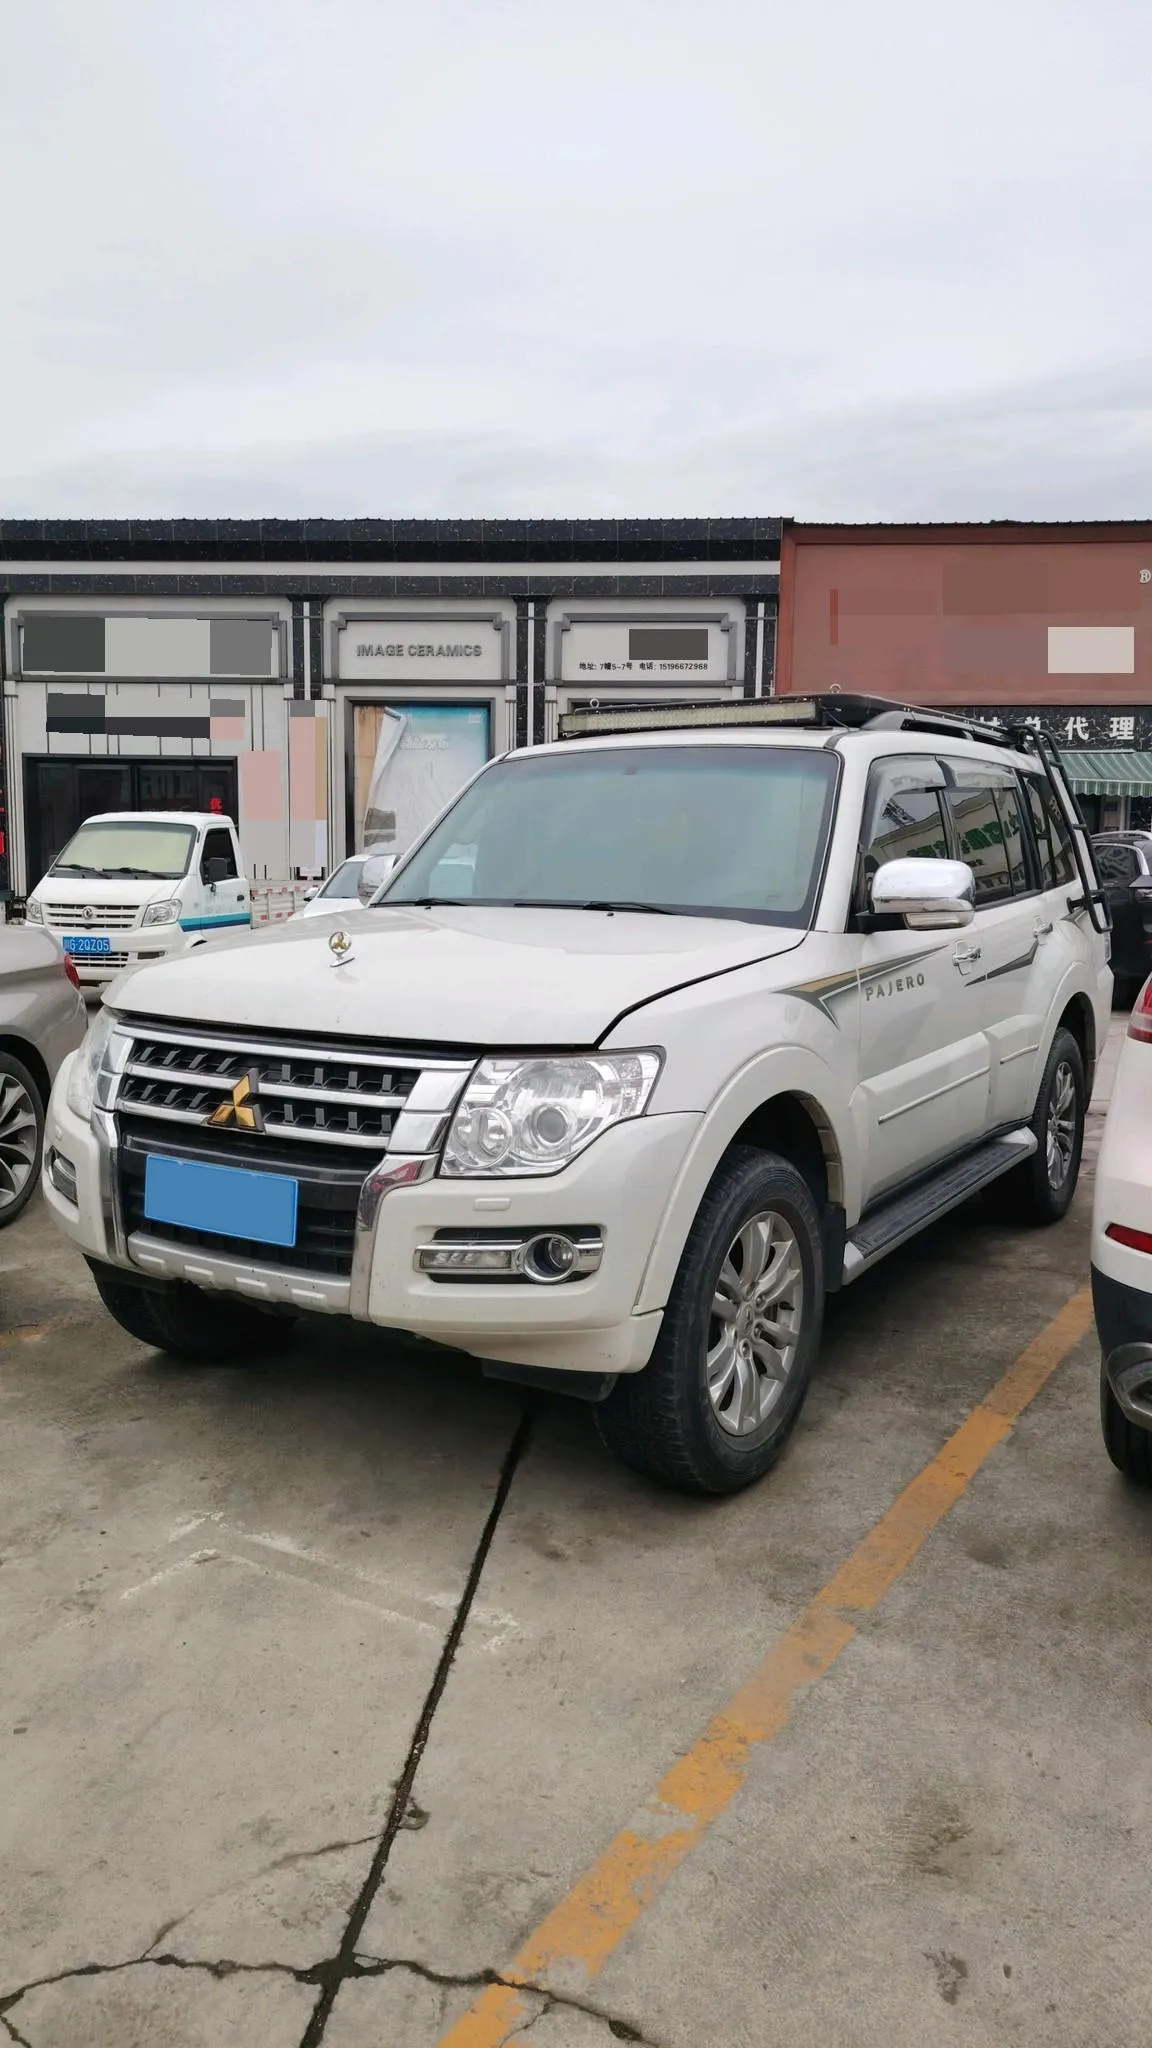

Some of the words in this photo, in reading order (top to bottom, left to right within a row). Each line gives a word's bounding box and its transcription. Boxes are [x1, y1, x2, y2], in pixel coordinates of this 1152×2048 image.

[356, 644, 404, 657] IMAGE
[407, 644, 482, 657] CERAMICS
[865, 972, 925, 1002] PAJERO
